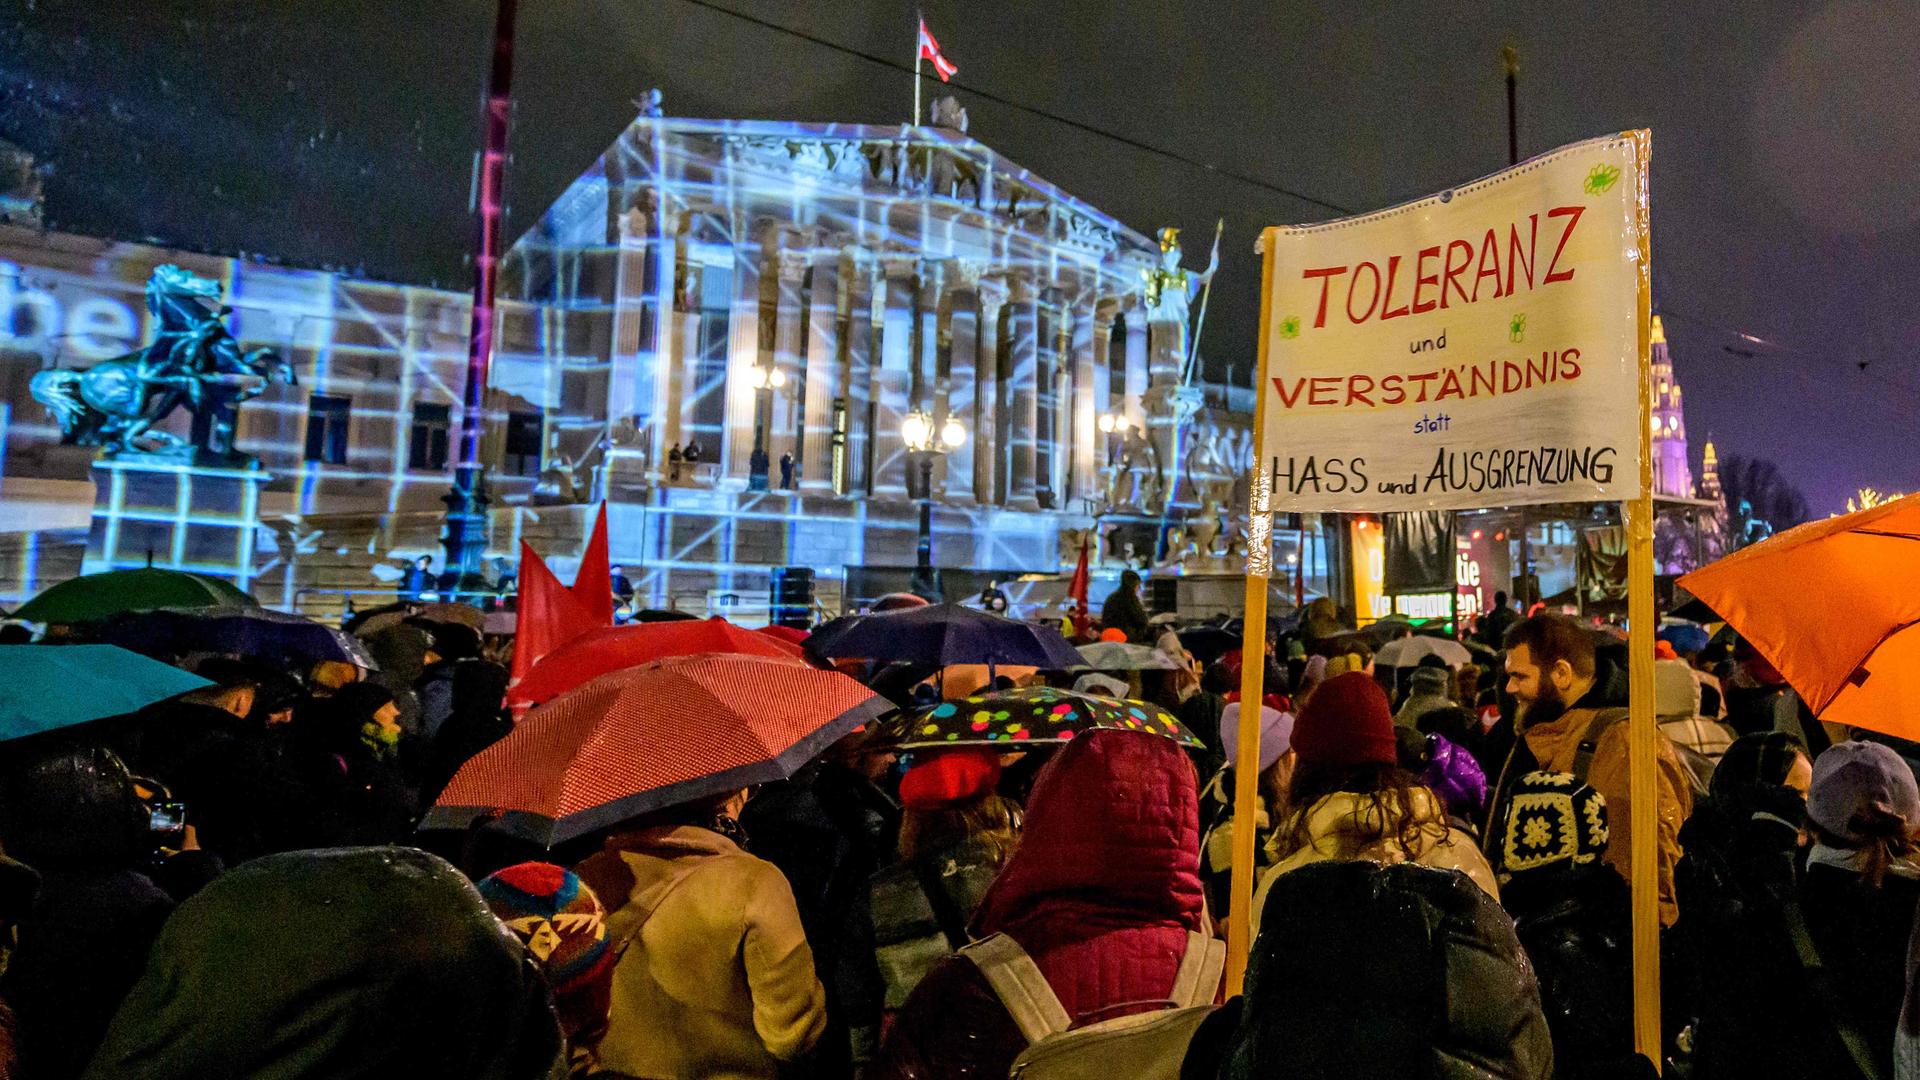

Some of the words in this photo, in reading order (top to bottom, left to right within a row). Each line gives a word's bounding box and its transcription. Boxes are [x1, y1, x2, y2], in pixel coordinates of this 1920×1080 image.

[1303, 206, 1586, 328] TOLERANZ
[1410, 329, 1447, 354] und
[1271, 348, 1582, 409] VERSTÄNDNIS
[1413, 413, 1451, 435] statt
[1271, 456, 1368, 495] HASS
[1378, 474, 1417, 495] und
[1423, 447, 1616, 493] AUSGRENZUNG
